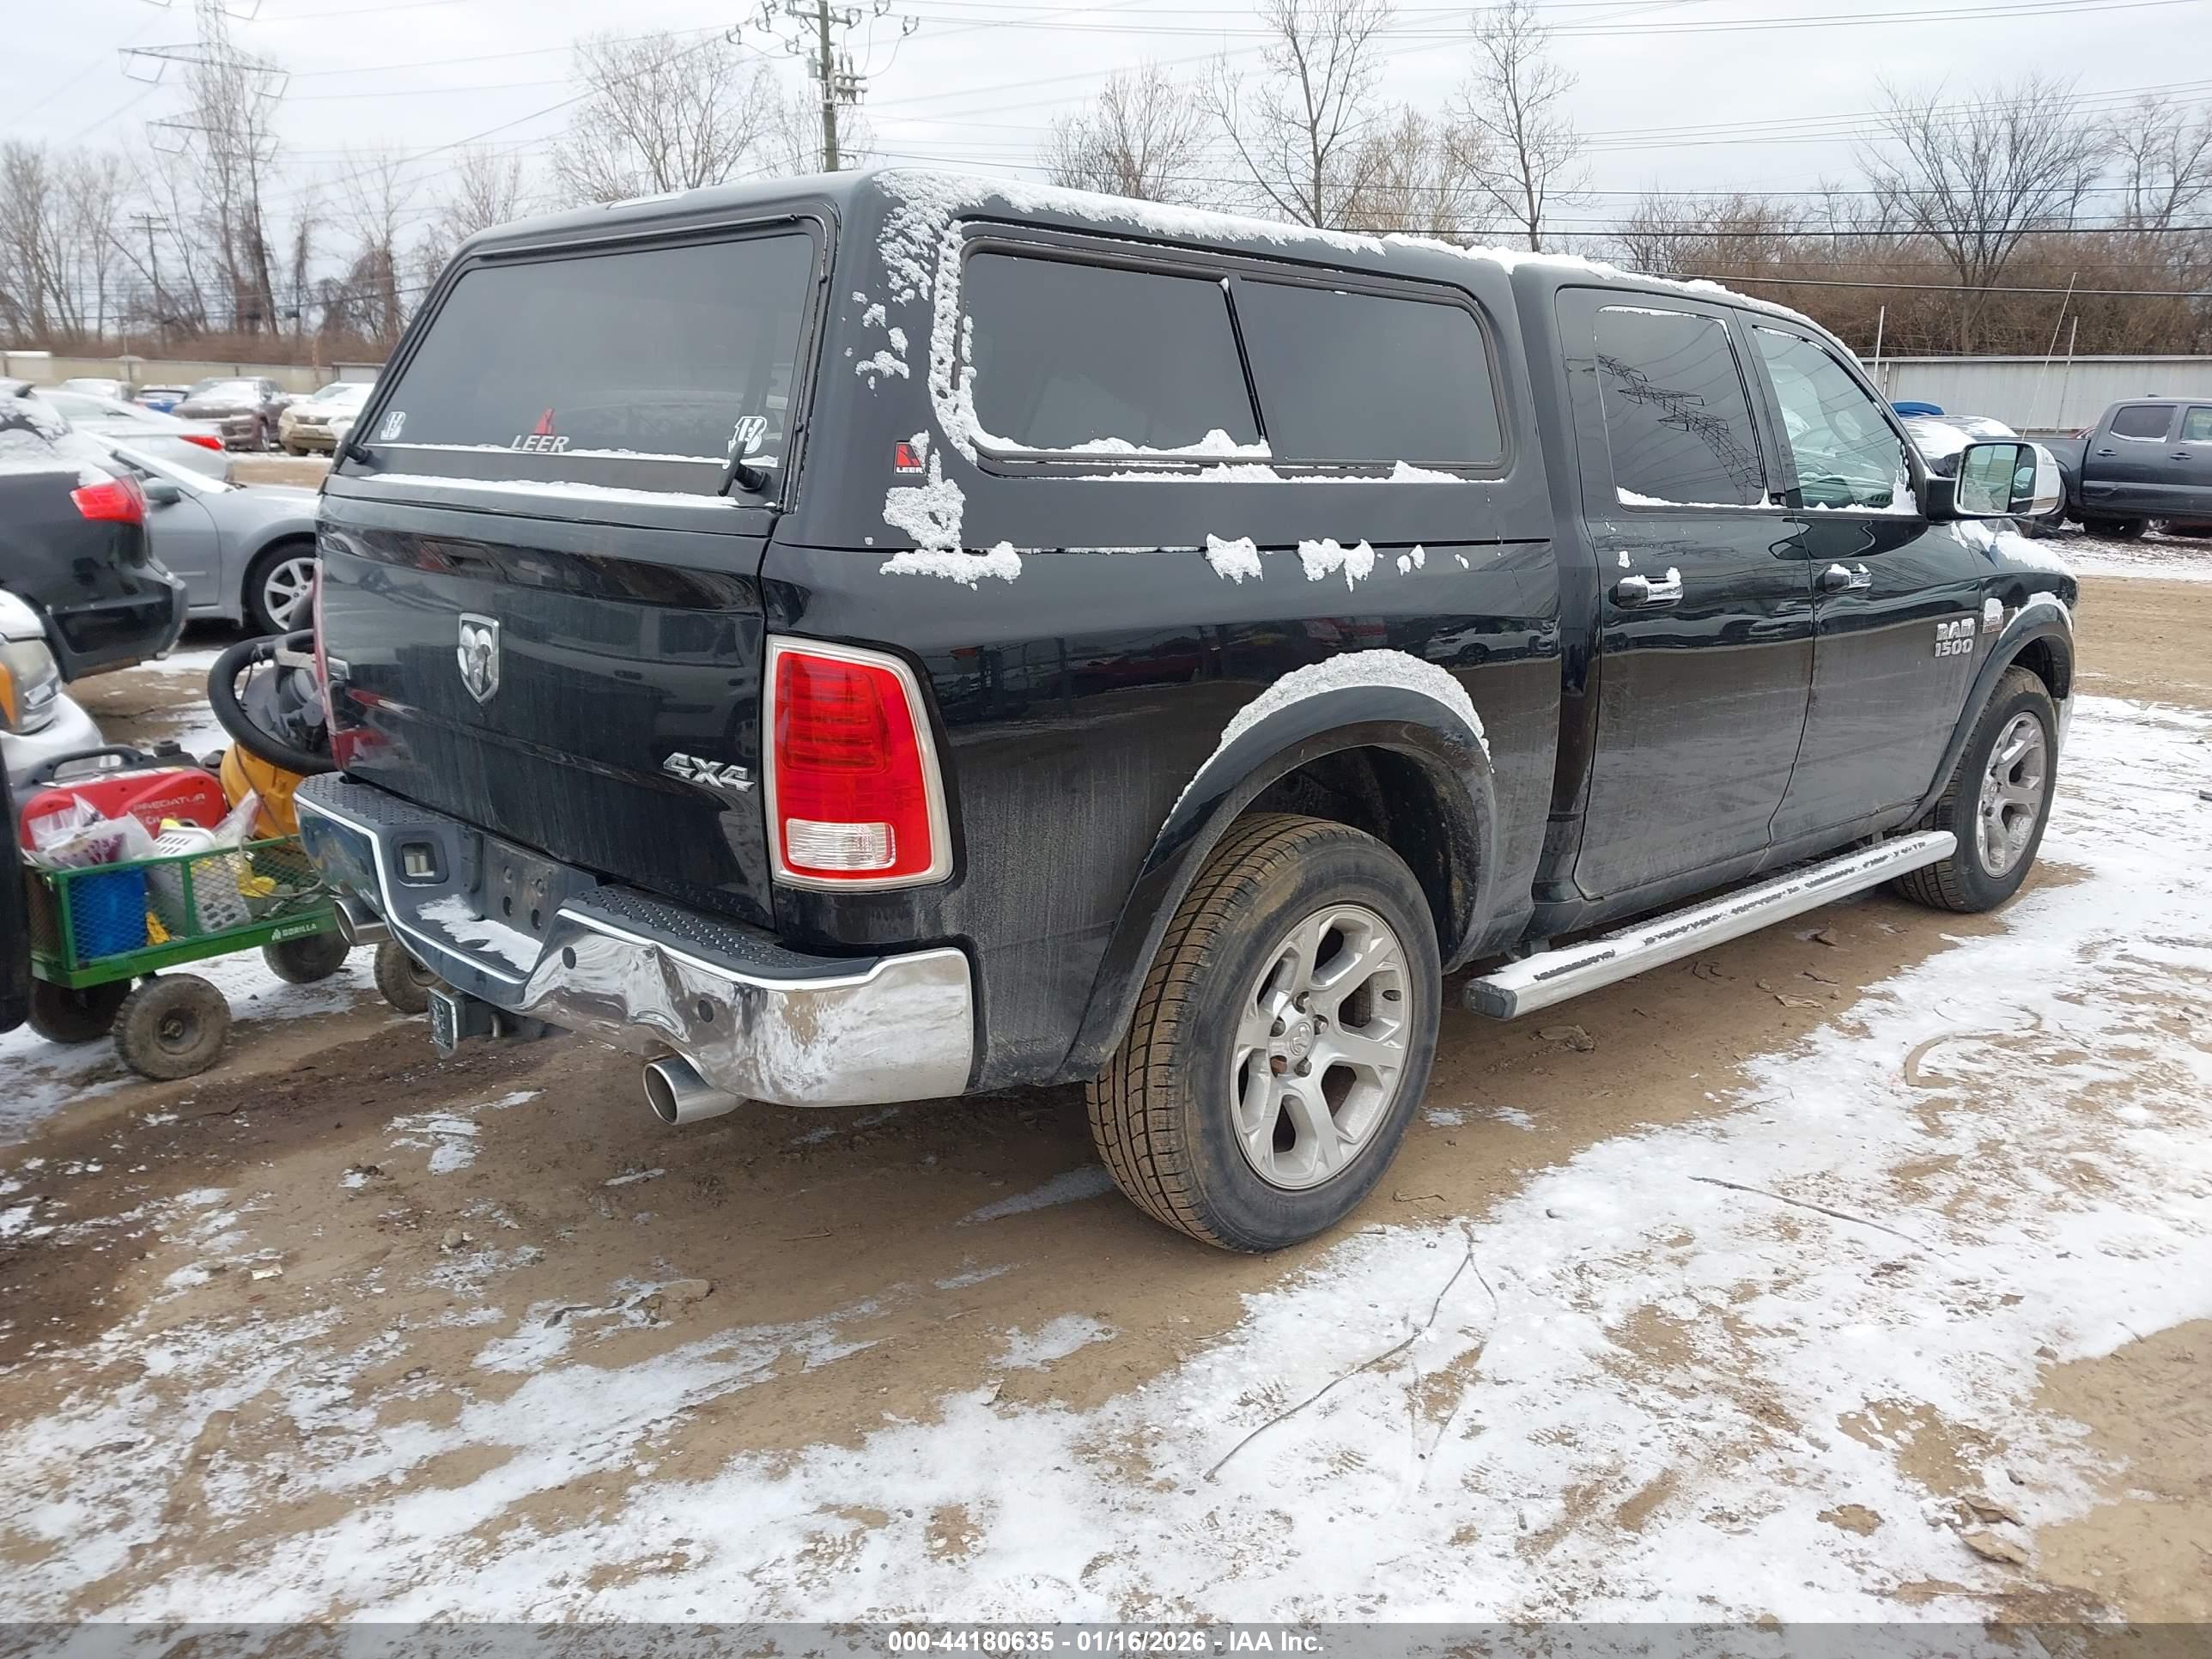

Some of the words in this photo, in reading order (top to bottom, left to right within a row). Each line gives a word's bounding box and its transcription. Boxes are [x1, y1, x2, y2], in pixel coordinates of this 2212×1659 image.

[511, 434, 570, 453] LEER
[1936, 617, 1975, 641] RAM
[1935, 638, 1974, 658] 1500
[282, 923, 317, 937] GORILLA
